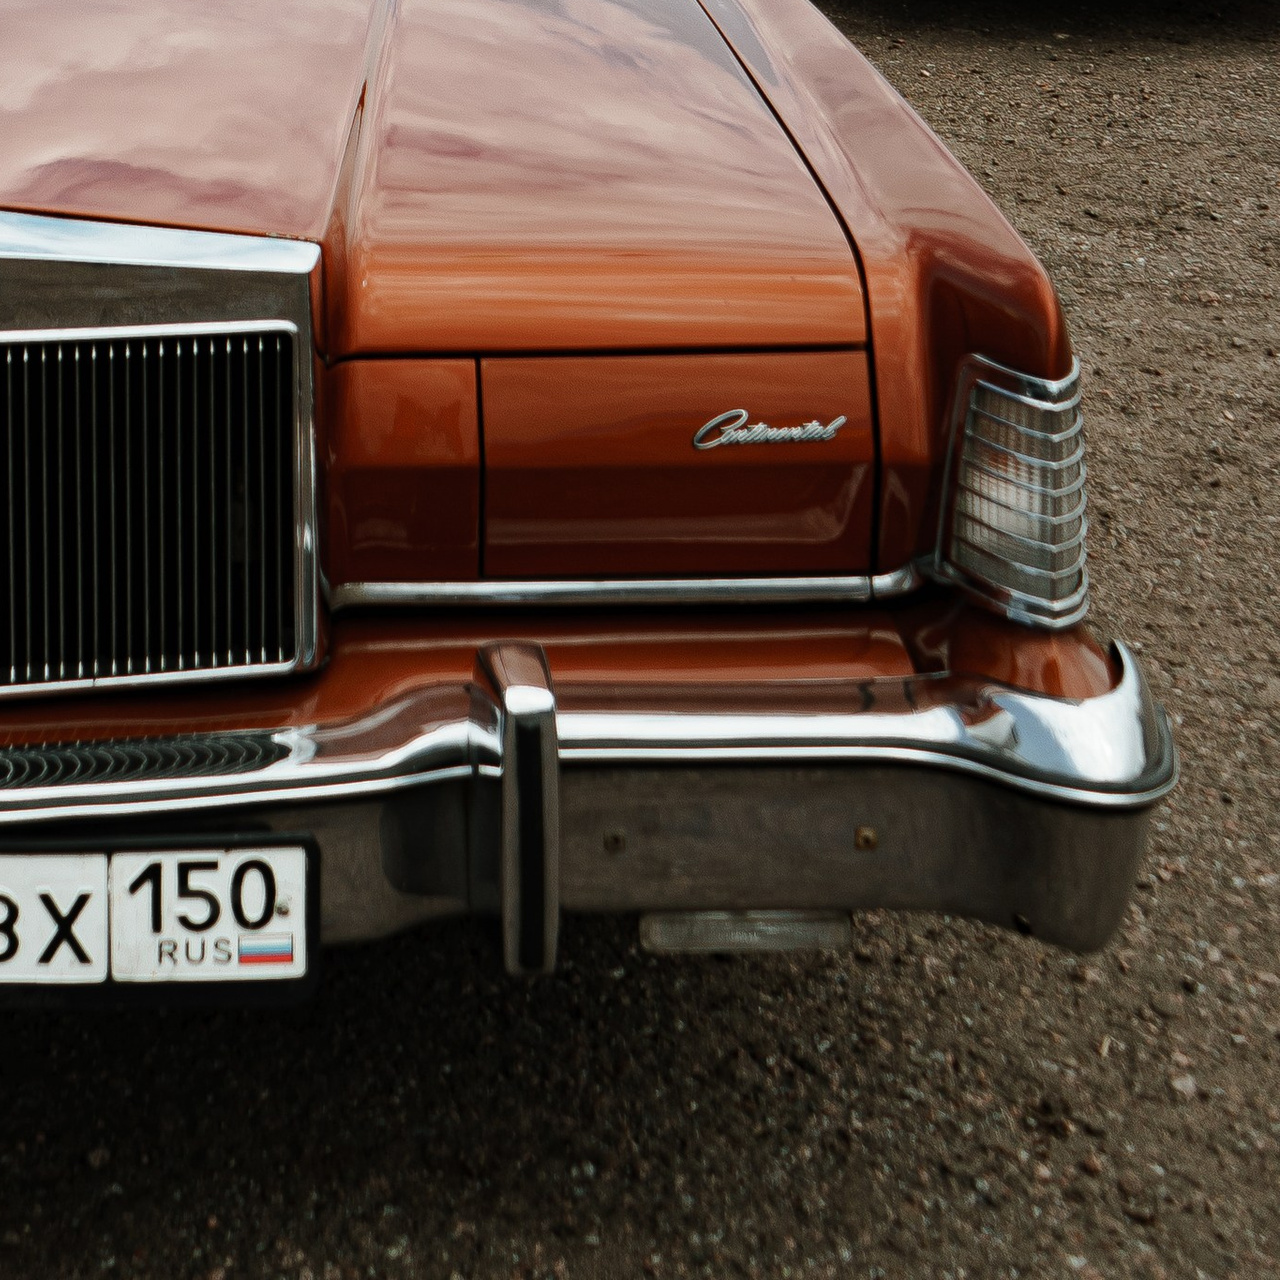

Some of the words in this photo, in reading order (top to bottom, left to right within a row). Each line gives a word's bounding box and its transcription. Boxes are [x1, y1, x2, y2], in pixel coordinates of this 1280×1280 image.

[693, 408, 848, 450] Continental
[127, 858, 279, 936] 150
[156, 937, 233, 966] RUS
